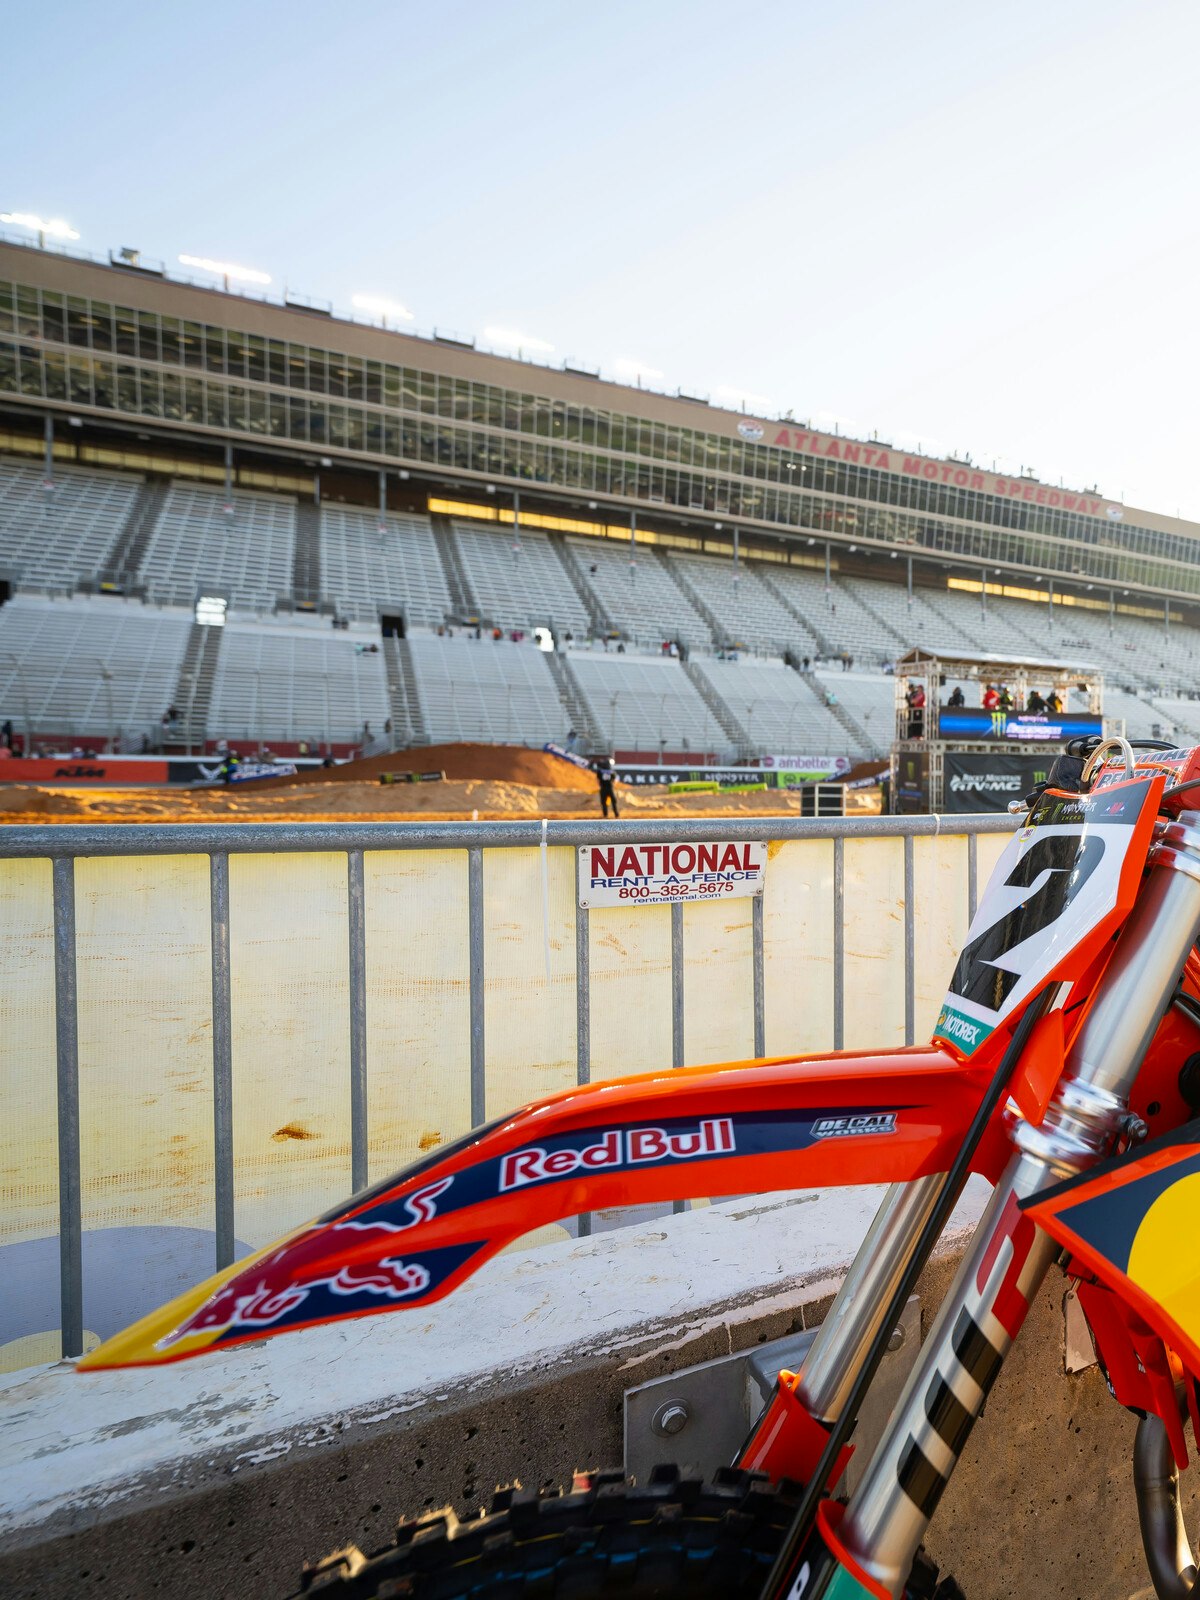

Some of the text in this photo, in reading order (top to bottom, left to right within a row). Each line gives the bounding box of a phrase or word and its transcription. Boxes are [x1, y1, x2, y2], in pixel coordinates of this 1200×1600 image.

[774, 429, 891, 470] ATLANTA
[902, 457, 985, 491] MOTOR
[993, 480, 1101, 516] SPEEDWAY
[778, 757, 831, 770] ambetter
[1061, 801, 1097, 814] MONSTER
[591, 844, 760, 877] NATIONAL
[590, 871, 758, 888] RENT-A-FENCE
[618, 882, 734, 899] 800-352-5675
[633, 892, 721, 904] rentnational.com
[948, 835, 1106, 1012] 2
[943, 1012, 980, 1046] MOTOREX
[817, 1114, 894, 1132] DECAL
[501, 1118, 735, 1190] Red Bull
